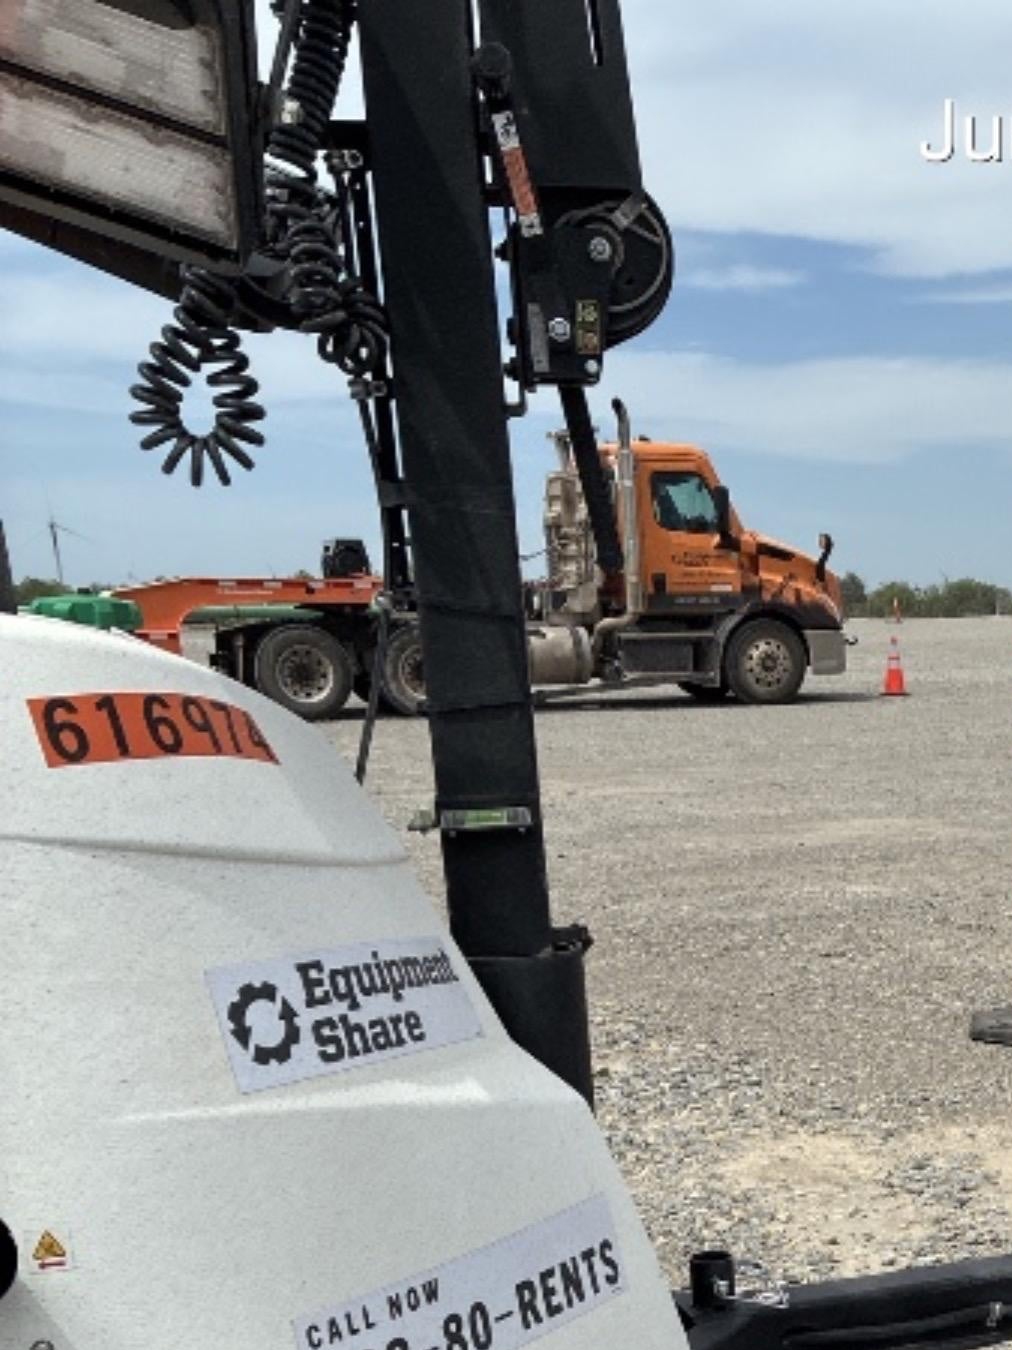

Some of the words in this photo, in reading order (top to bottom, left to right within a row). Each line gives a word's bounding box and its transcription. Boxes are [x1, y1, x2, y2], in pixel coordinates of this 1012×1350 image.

[43, 694, 282, 767] 616974
[296, 948, 459, 1011] Equipment
[311, 1010, 426, 1063] Share
[306, 1305, 376, 1350] CALL
[386, 1277, 440, 1321] NOW
